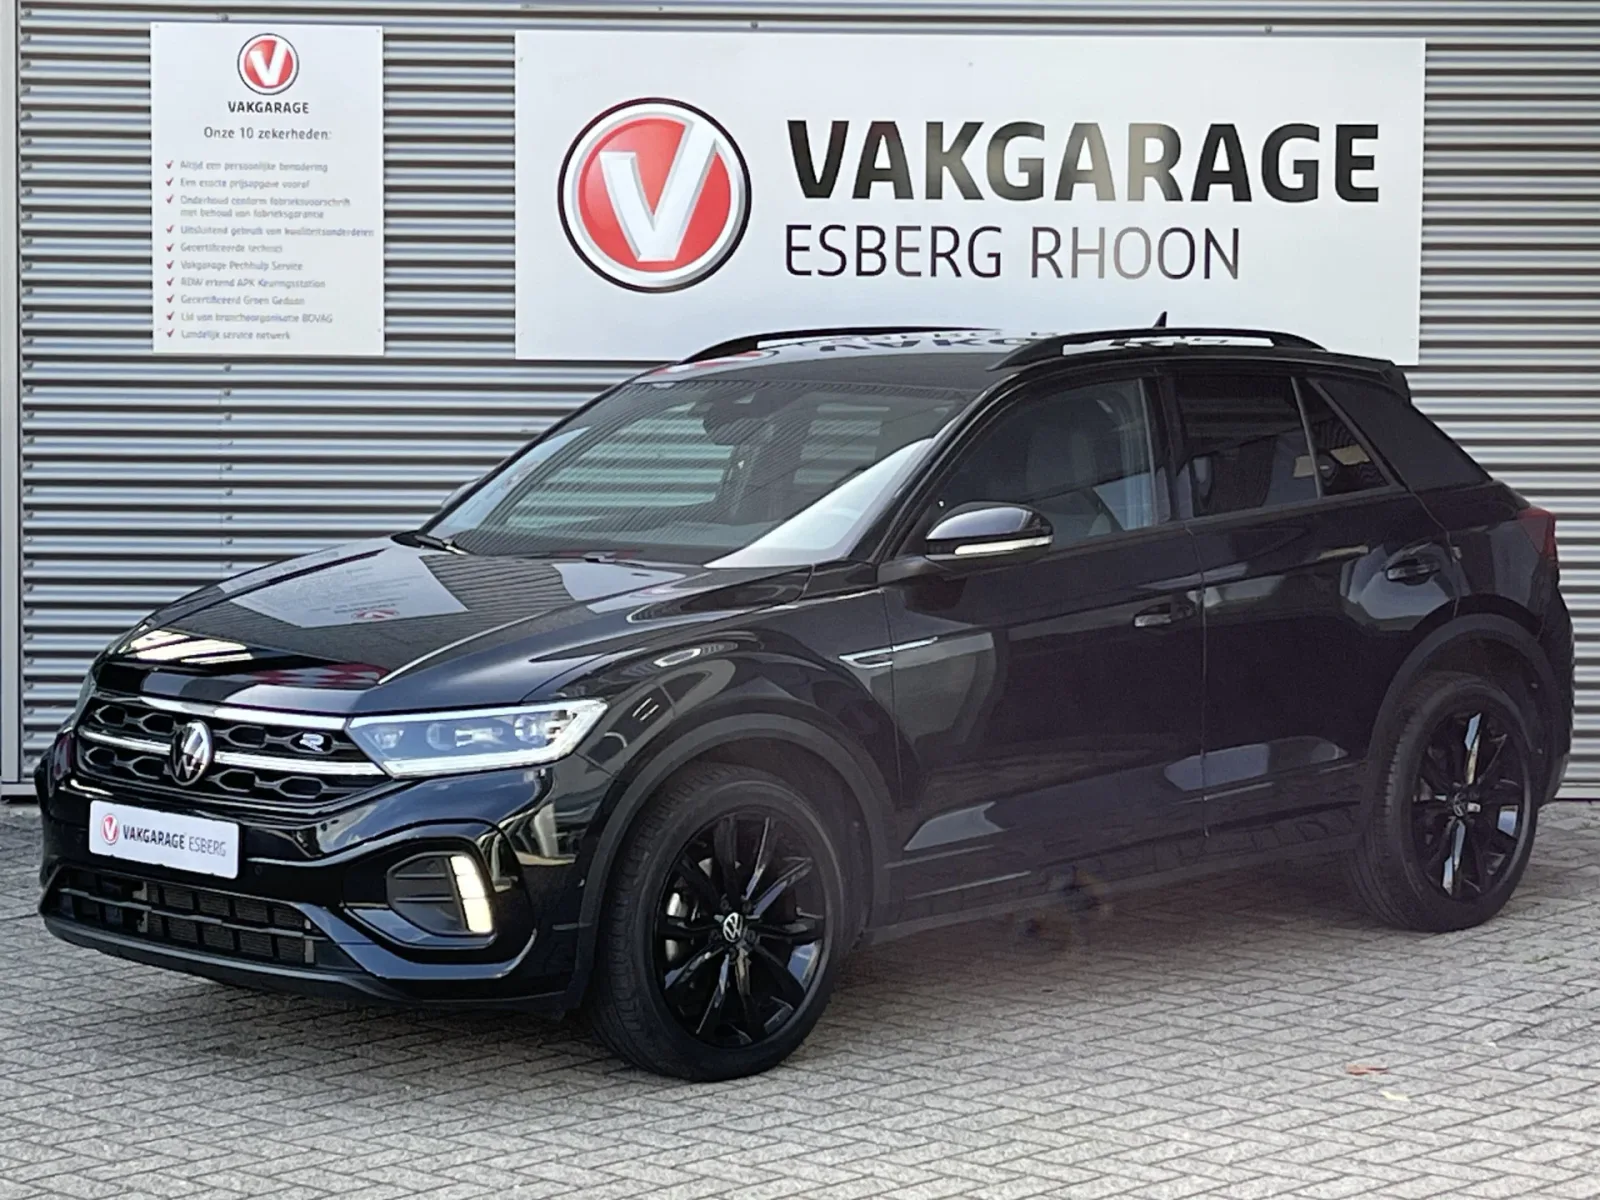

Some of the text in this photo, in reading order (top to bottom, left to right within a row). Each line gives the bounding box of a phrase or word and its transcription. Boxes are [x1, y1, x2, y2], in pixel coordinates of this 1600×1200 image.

[228, 101, 309, 114] VAKGARAGE
[204, 127, 235, 139] Onze
[240, 127, 253, 139] 10
[787, 120, 1379, 203] VAKGARAGE
[787, 224, 1239, 280] ESBERG RHOON
[123, 825, 227, 857] VAKGARAGE ESBERG
